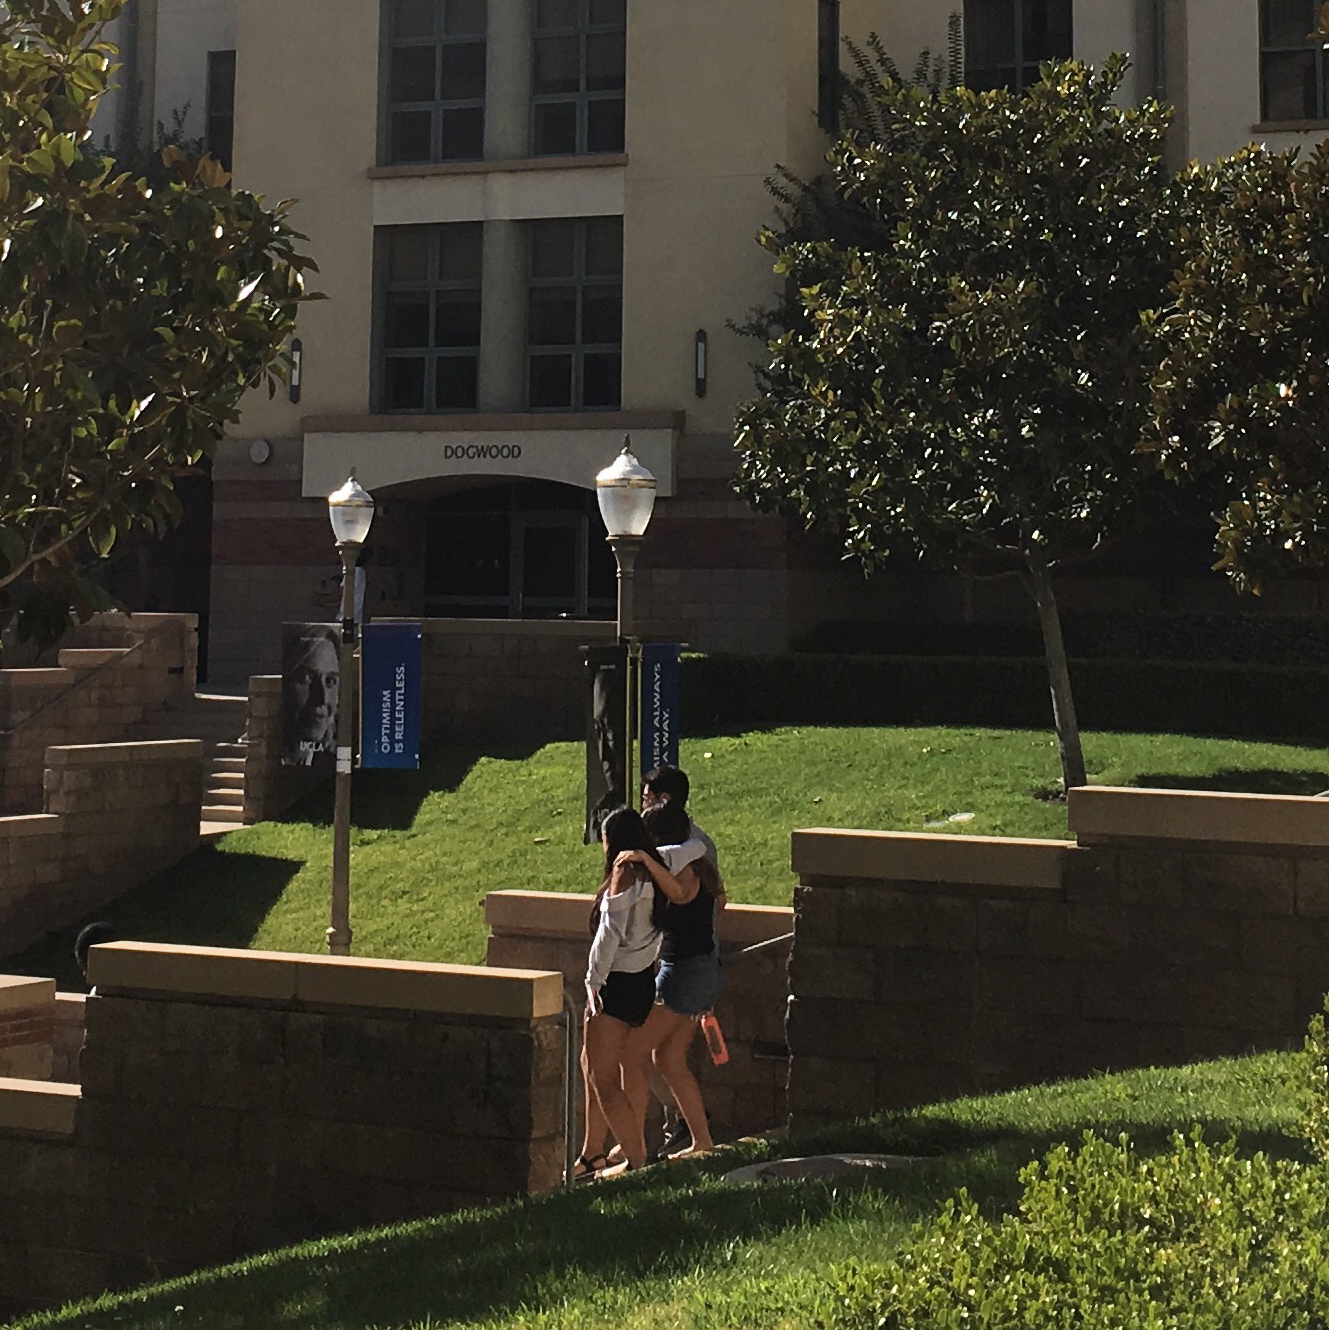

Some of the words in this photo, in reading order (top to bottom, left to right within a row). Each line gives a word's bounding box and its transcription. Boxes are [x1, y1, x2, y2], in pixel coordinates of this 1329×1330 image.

[444, 444, 522, 459] DOGWOOD
[395, 663, 405, 740] RELENTLESS.
[653, 663, 661, 728] ALWAYS
[381, 689, 391, 754] OPTIMISM
[662, 708, 670, 748] WAY.
[300, 741, 324, 752] UCLA
[395, 742, 404, 753] IS
[662, 750, 670, 763] A
